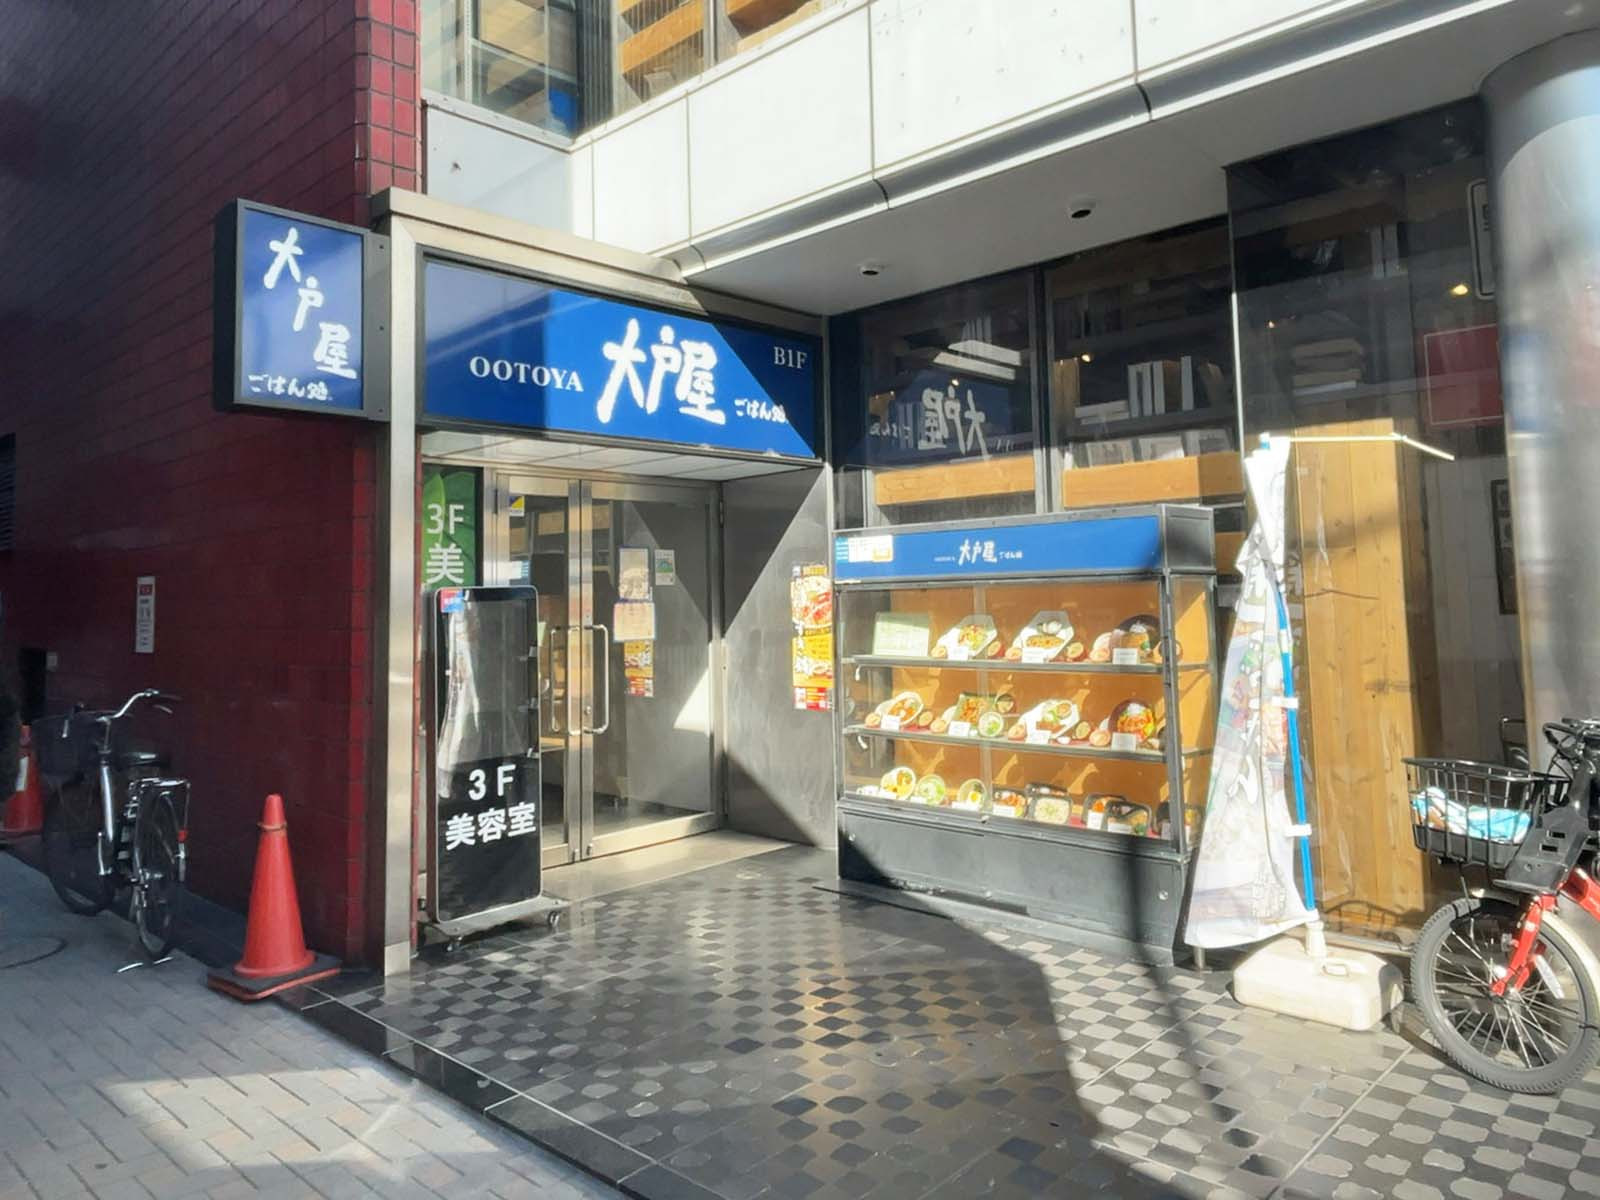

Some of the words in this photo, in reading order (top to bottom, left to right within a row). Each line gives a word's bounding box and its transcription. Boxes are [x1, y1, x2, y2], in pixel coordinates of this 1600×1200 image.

[469, 356, 584, 392] OOTOYA
[774, 346, 808, 369] B1F
[427, 504, 464, 535] 3F
[445, 802, 537, 851] 美容室
